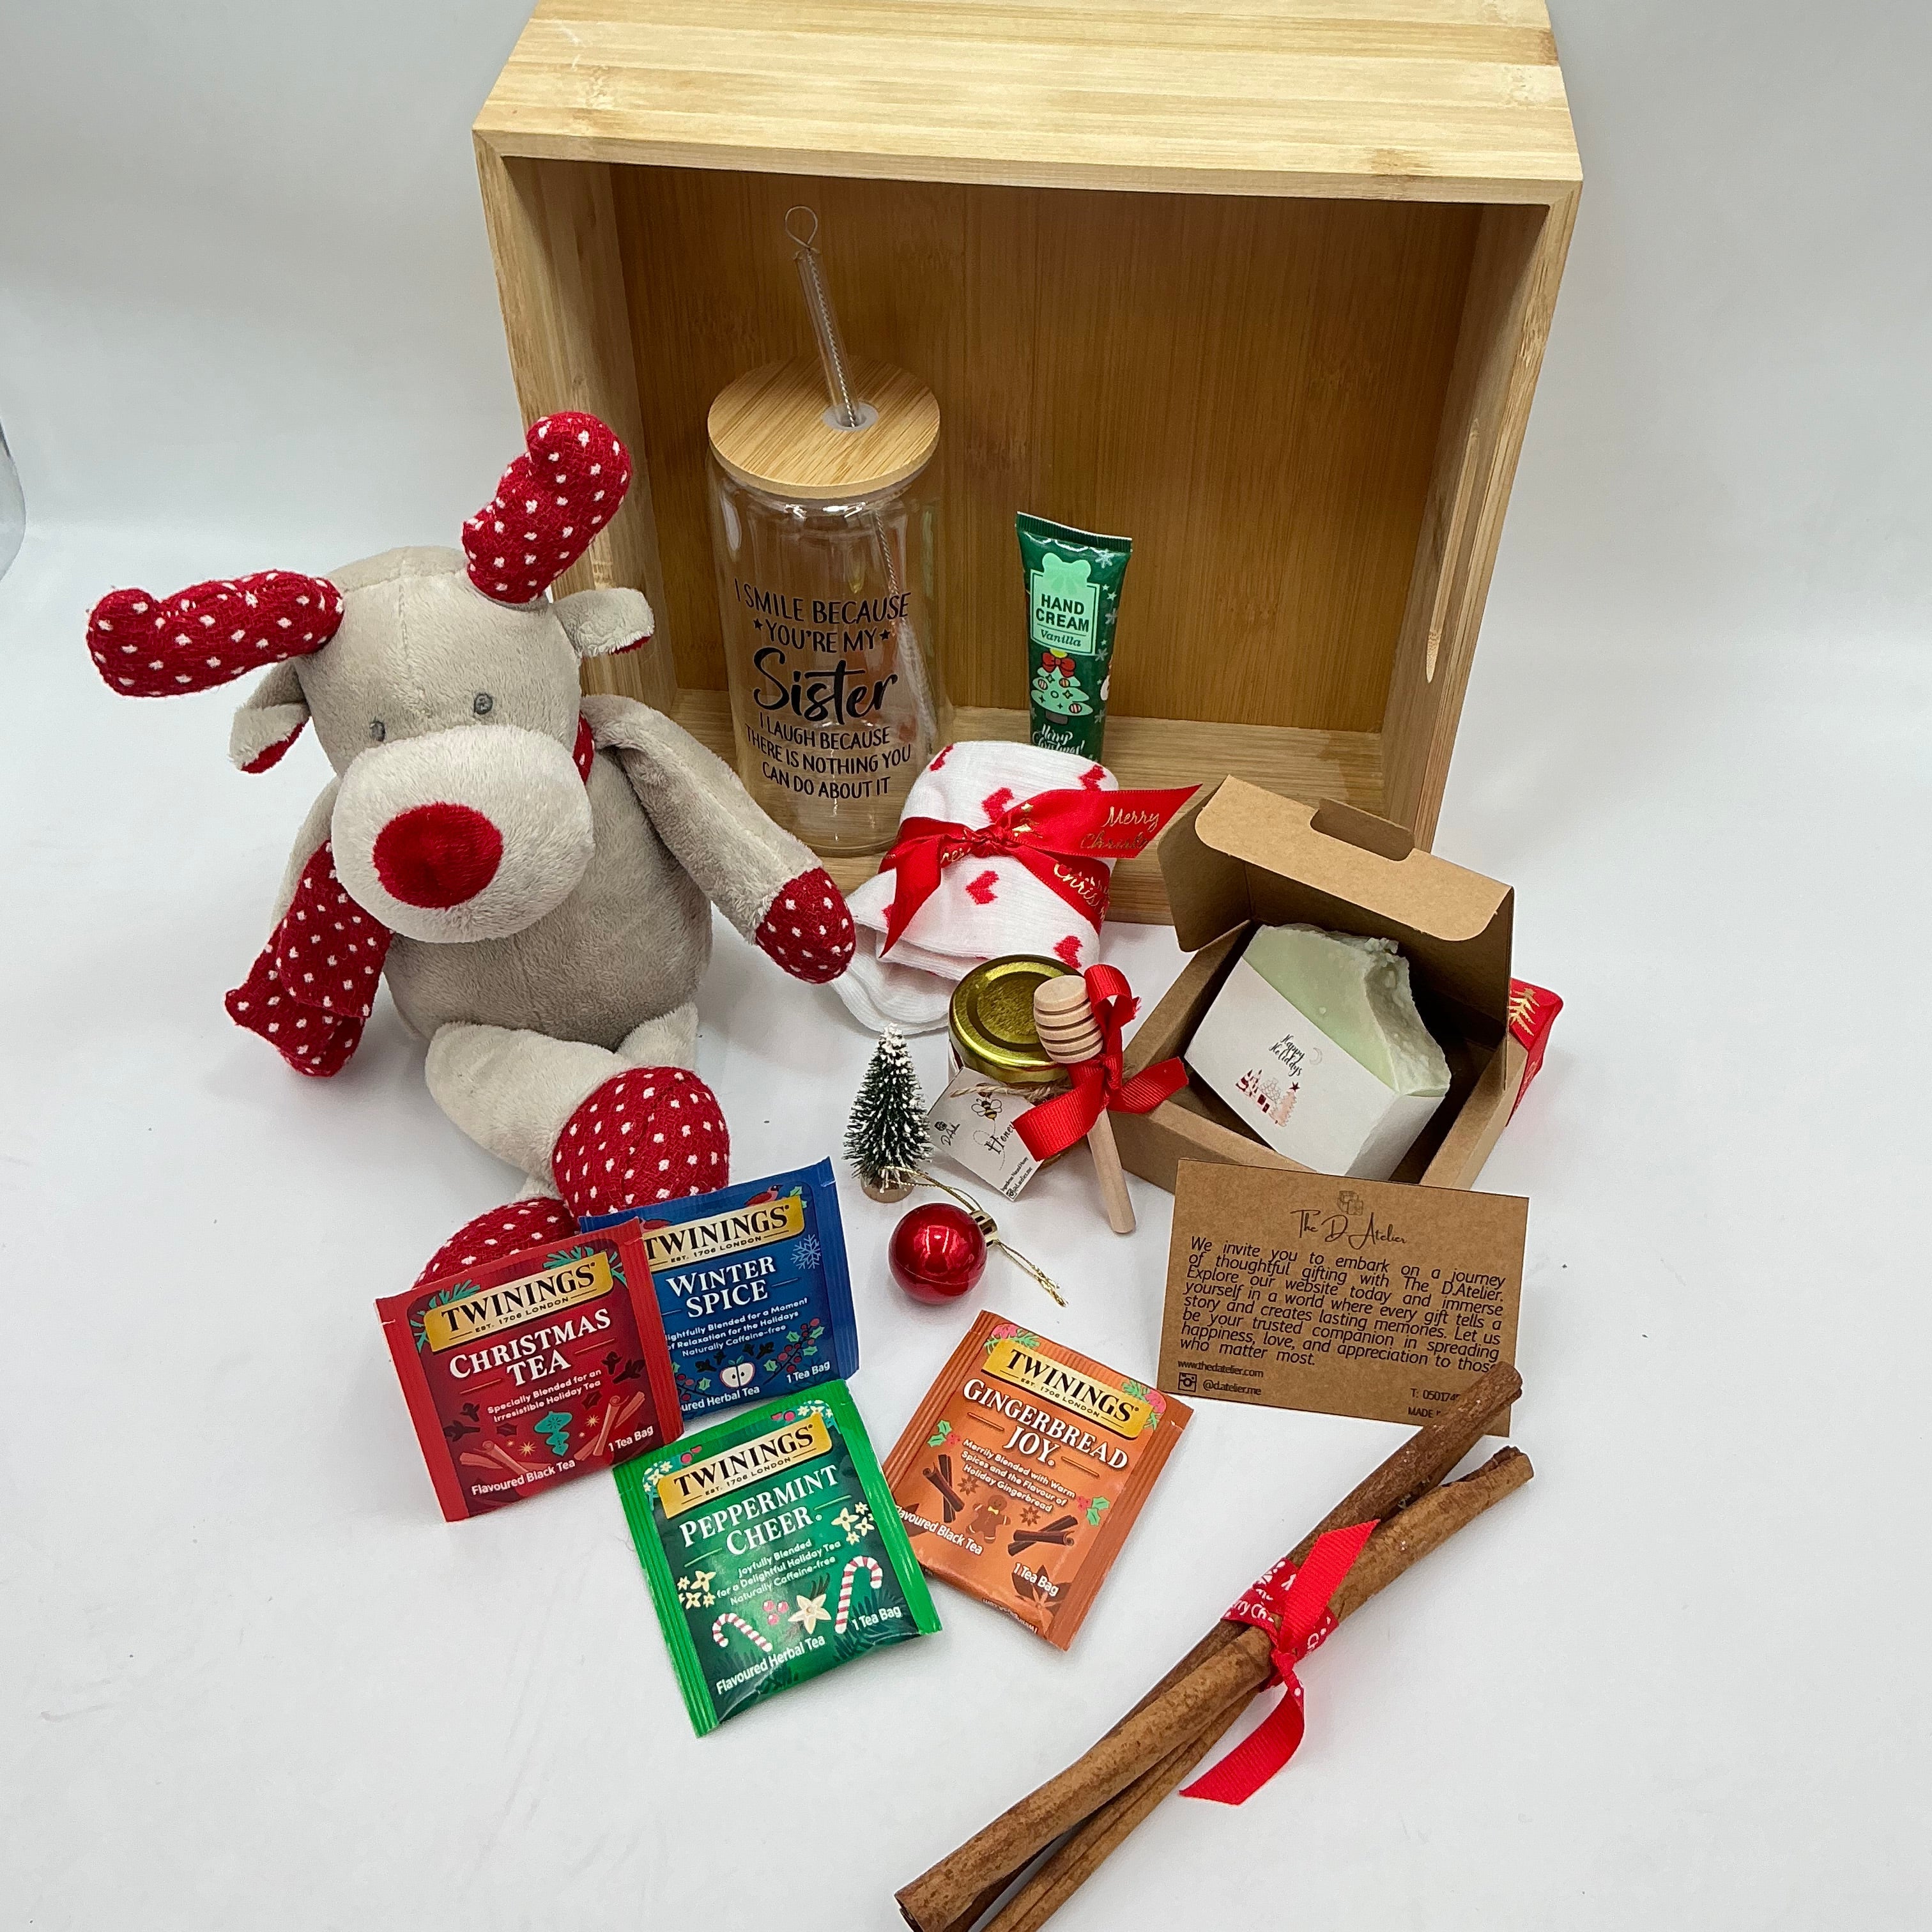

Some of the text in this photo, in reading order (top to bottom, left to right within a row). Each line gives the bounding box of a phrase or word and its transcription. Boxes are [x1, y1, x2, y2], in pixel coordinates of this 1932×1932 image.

[735, 578, 911, 624] I SMILE BECAUSE
[1041, 593, 1084, 615] HAND
[765, 619, 877, 653] YOU'RE MY
[1036, 608, 1089, 633] CREAM
[1040, 629, 1082, 647] Vanilla
[753, 647, 898, 725] Sister
[745, 723, 911, 774] THERE IS NOTHING YOU
[767, 715, 891, 750] LAUGH BECAUSE
[762, 762, 891, 799] CAN DO ABOUT IT
[1101, 806, 1160, 832] Merry
[1280, 1034, 1305, 1066] Happy
[1290, 1209, 1321, 1238] The
[720, 1236, 762, 1251] LONDON
[665, 1256, 776, 1297] WINTER
[1188, 1252, 1504, 1302] of thoughtful gifting with The D.Atelier.
[1191, 1236, 1506, 1290] We invite you to embark on a journey
[441, 1263, 595, 1332] TWININGS
[525, 1296, 569, 1315] LONDON
[686, 1280, 769, 1317] SPICE
[1183, 1282, 1502, 1330] yourself in a world where every gift tells a
[1187, 1264, 1503, 1316] Explore our website today and immerse
[677, 1311, 799, 1349] Relaxation for the Holidays
[708, 1315, 746, 1331] Blended
[747, 1311, 762, 1321] for
[770, 1297, 808, 1314] Moment
[1183, 1296, 1501, 1345] story and creates lasting memories. Let us
[449, 1308, 611, 1379] CHRISTMAS
[682, 1324, 786, 1357] Naturally Caffeine-free
[1180, 1337, 1315, 1366] who matter most.
[1181, 1321, 1451, 1368] happiness, love, and appreciation to
[1183, 1307, 1499, 1363] be your trusted companion in spreading
[507, 1349, 571, 1386] TEA
[793, 1361, 831, 1381] Tea Bag
[1006, 1349, 1135, 1422] TWININGS
[487, 1369, 602, 1414] Specially Blended for an
[493, 1380, 601, 1423] Irresistible Holiday Tea
[707, 1390, 741, 1406] Herbal
[742, 1385, 760, 1397] Tea
[1062, 1396, 1100, 1418] LONDON
[1411, 1388, 1419, 1399] T:
[963, 1378, 1129, 1469] GINGERBREAD
[1407, 1406, 1434, 1418] MADE
[615, 1426, 654, 1449] Tea Bag
[471, 1459, 576, 1496] Flavoured Black Tea
[673, 1426, 813, 1497] TWININGS
[751, 1456, 792, 1477] LONDON
[961, 1451, 1068, 1506] Spices and the Flavour of
[963, 1439, 1076, 1498] Merrily Blended with Warm
[678, 1464, 839, 1548] PEPPERMINT
[963, 1464, 1053, 1513] Holiday Gingerbread
[738, 1538, 813, 1577] Joyfully Blended
[937, 1525, 984, 1556] Black Tea
[716, 1540, 841, 1598] for a Delightful Holiday Tea
[730, 1556, 836, 1606] Naturally Caffeine-free
[1020, 1566, 1059, 1597] Tea Bag
[859, 1606, 903, 1629] Tea Bag
[716, 1635, 826, 1695] Flavoured Herbal Tea
